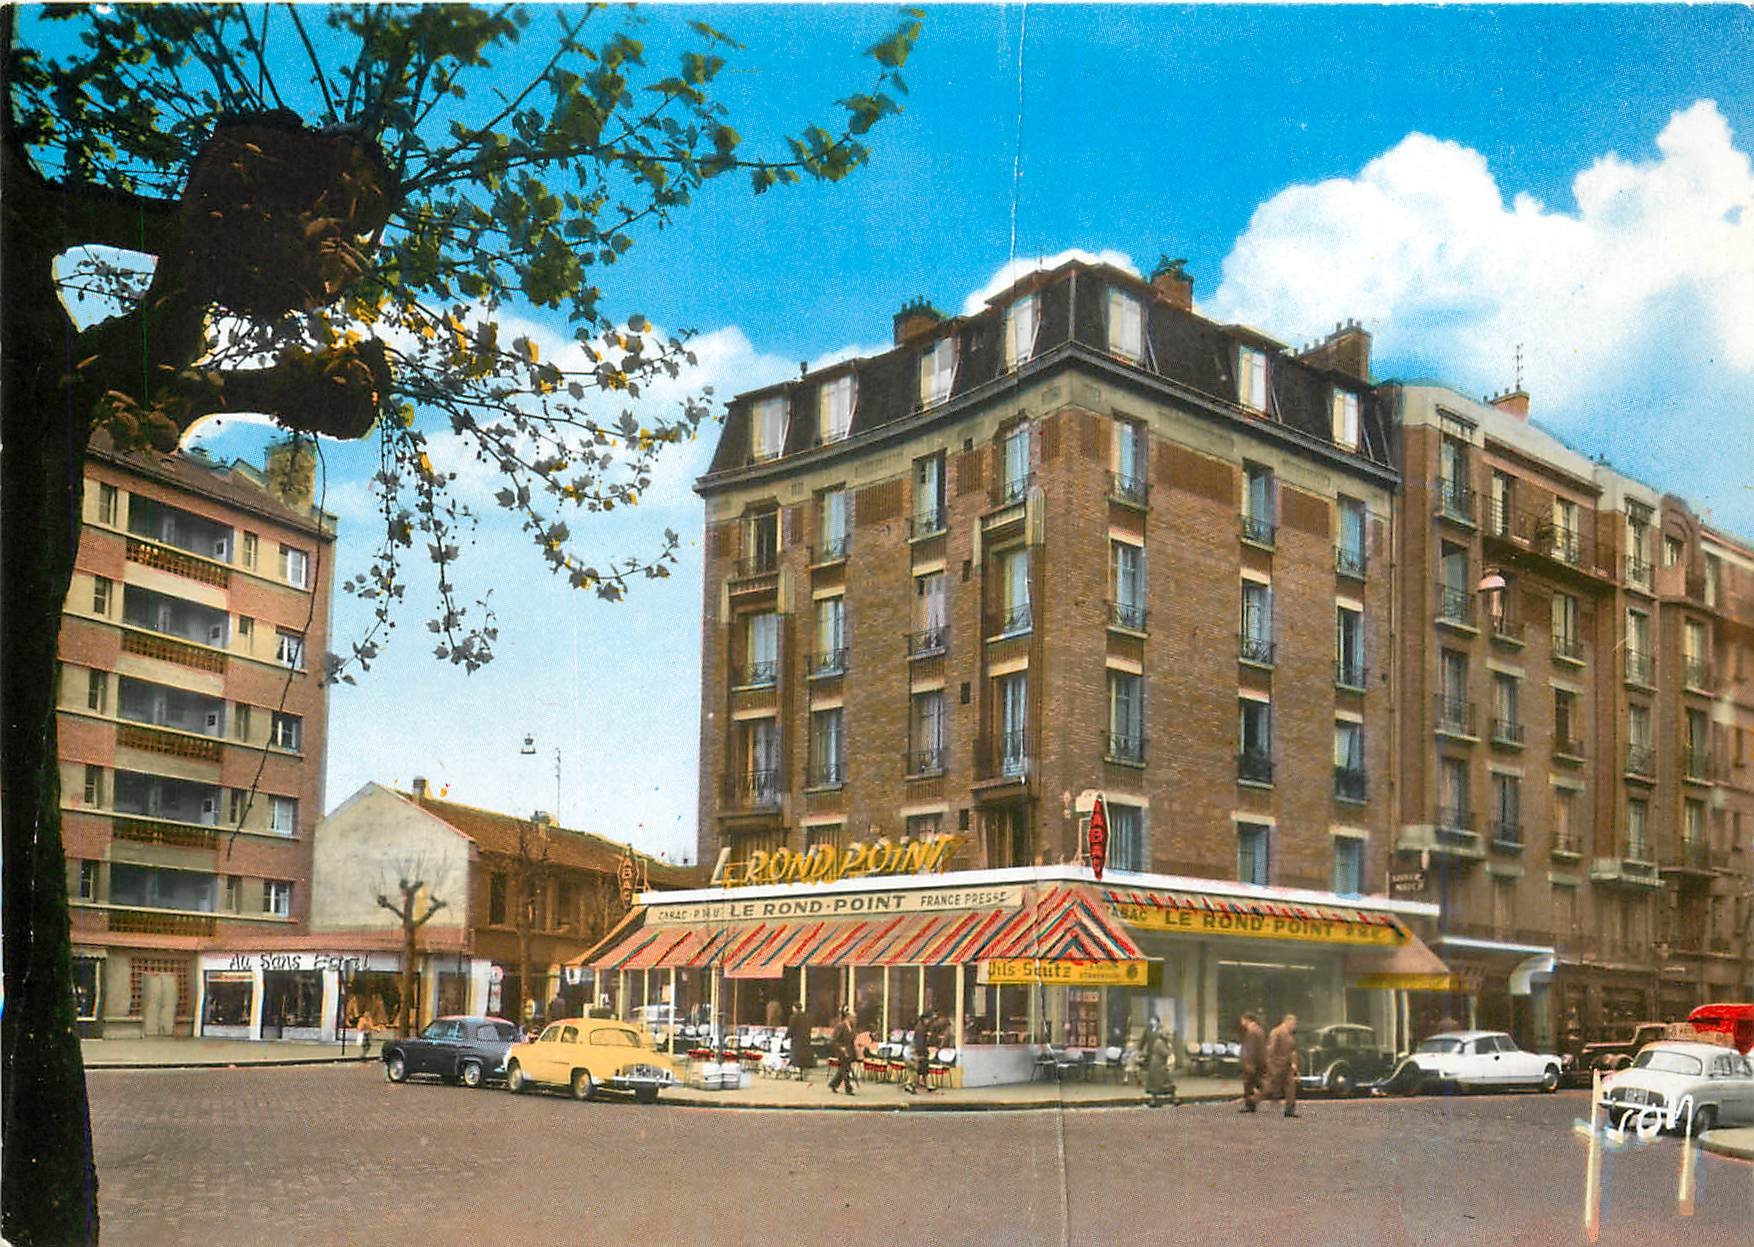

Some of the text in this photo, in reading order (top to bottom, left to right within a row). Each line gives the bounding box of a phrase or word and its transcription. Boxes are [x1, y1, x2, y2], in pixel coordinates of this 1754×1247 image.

[743, 844, 836, 886] ROND
[839, 833, 964, 878] POINT
[920, 891, 1007, 906] FRANCE PRESSE
[730, 903, 754, 917] LE
[1165, 909, 1192, 925] LE
[229, 953, 252, 971] Au
[260, 952, 302, 971] Sans
